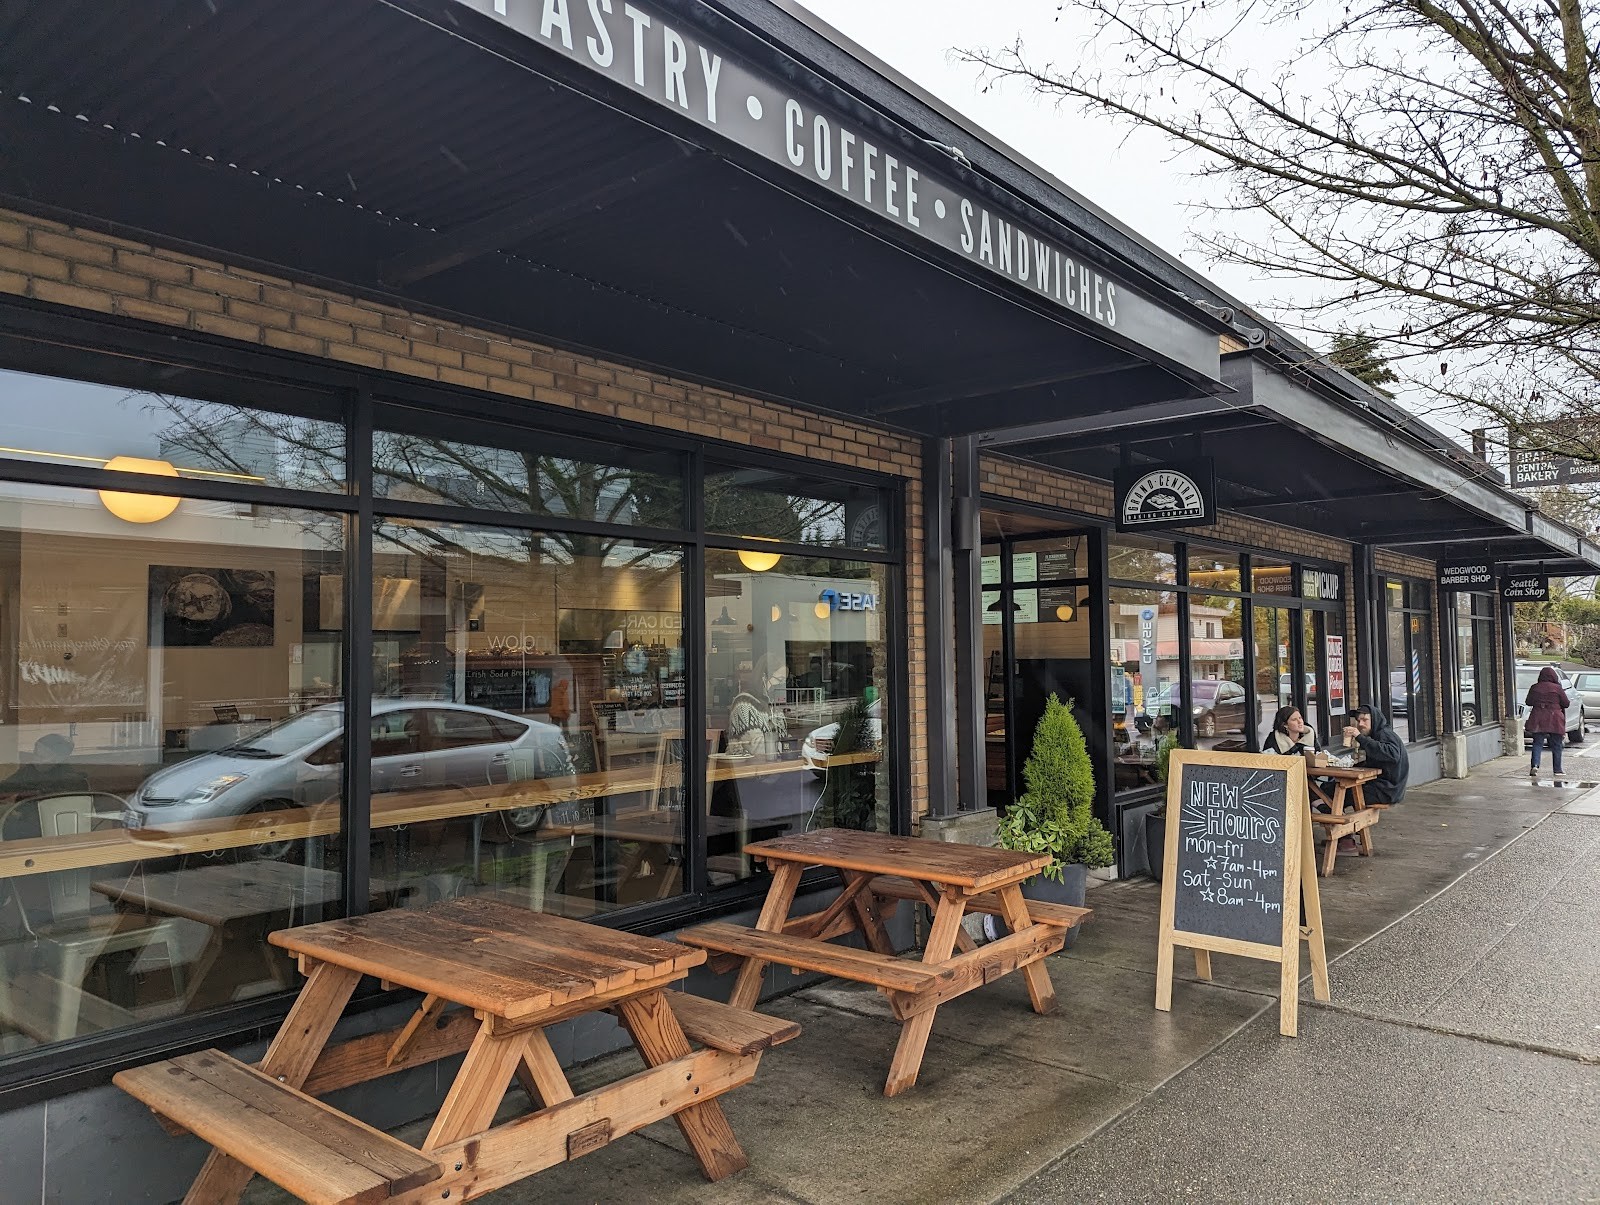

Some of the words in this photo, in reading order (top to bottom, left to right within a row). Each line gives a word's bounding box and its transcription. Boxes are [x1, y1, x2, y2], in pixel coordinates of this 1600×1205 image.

[493, 0, 722, 124] ASTRY
[785, 98, 920, 228] COFFEE
[960, 198, 1117, 327] SANDWICHES
[1516, 452, 1556, 464] GRA
[1516, 470, 1560, 483] BAKERY
[1128, 479, 1154, 511] GRAND
[1159, 474, 1198, 507] CENTRAL
[1161, 508, 1199, 518] COMPANY
[1443, 565, 1487, 575] WEDGWOOD
[1440, 575, 1470, 585] BARBER
[1470, 574, 1491, 584] SHOP
[1510, 578, 1539, 588] Seattle
[1314, 571, 1339, 600] PICKUP
[1504, 588, 1523, 597] Coin
[1524, 587, 1545, 598] Shop
[489, 669, 509, 679] Soda
[1190, 780, 1239, 809] NEW
